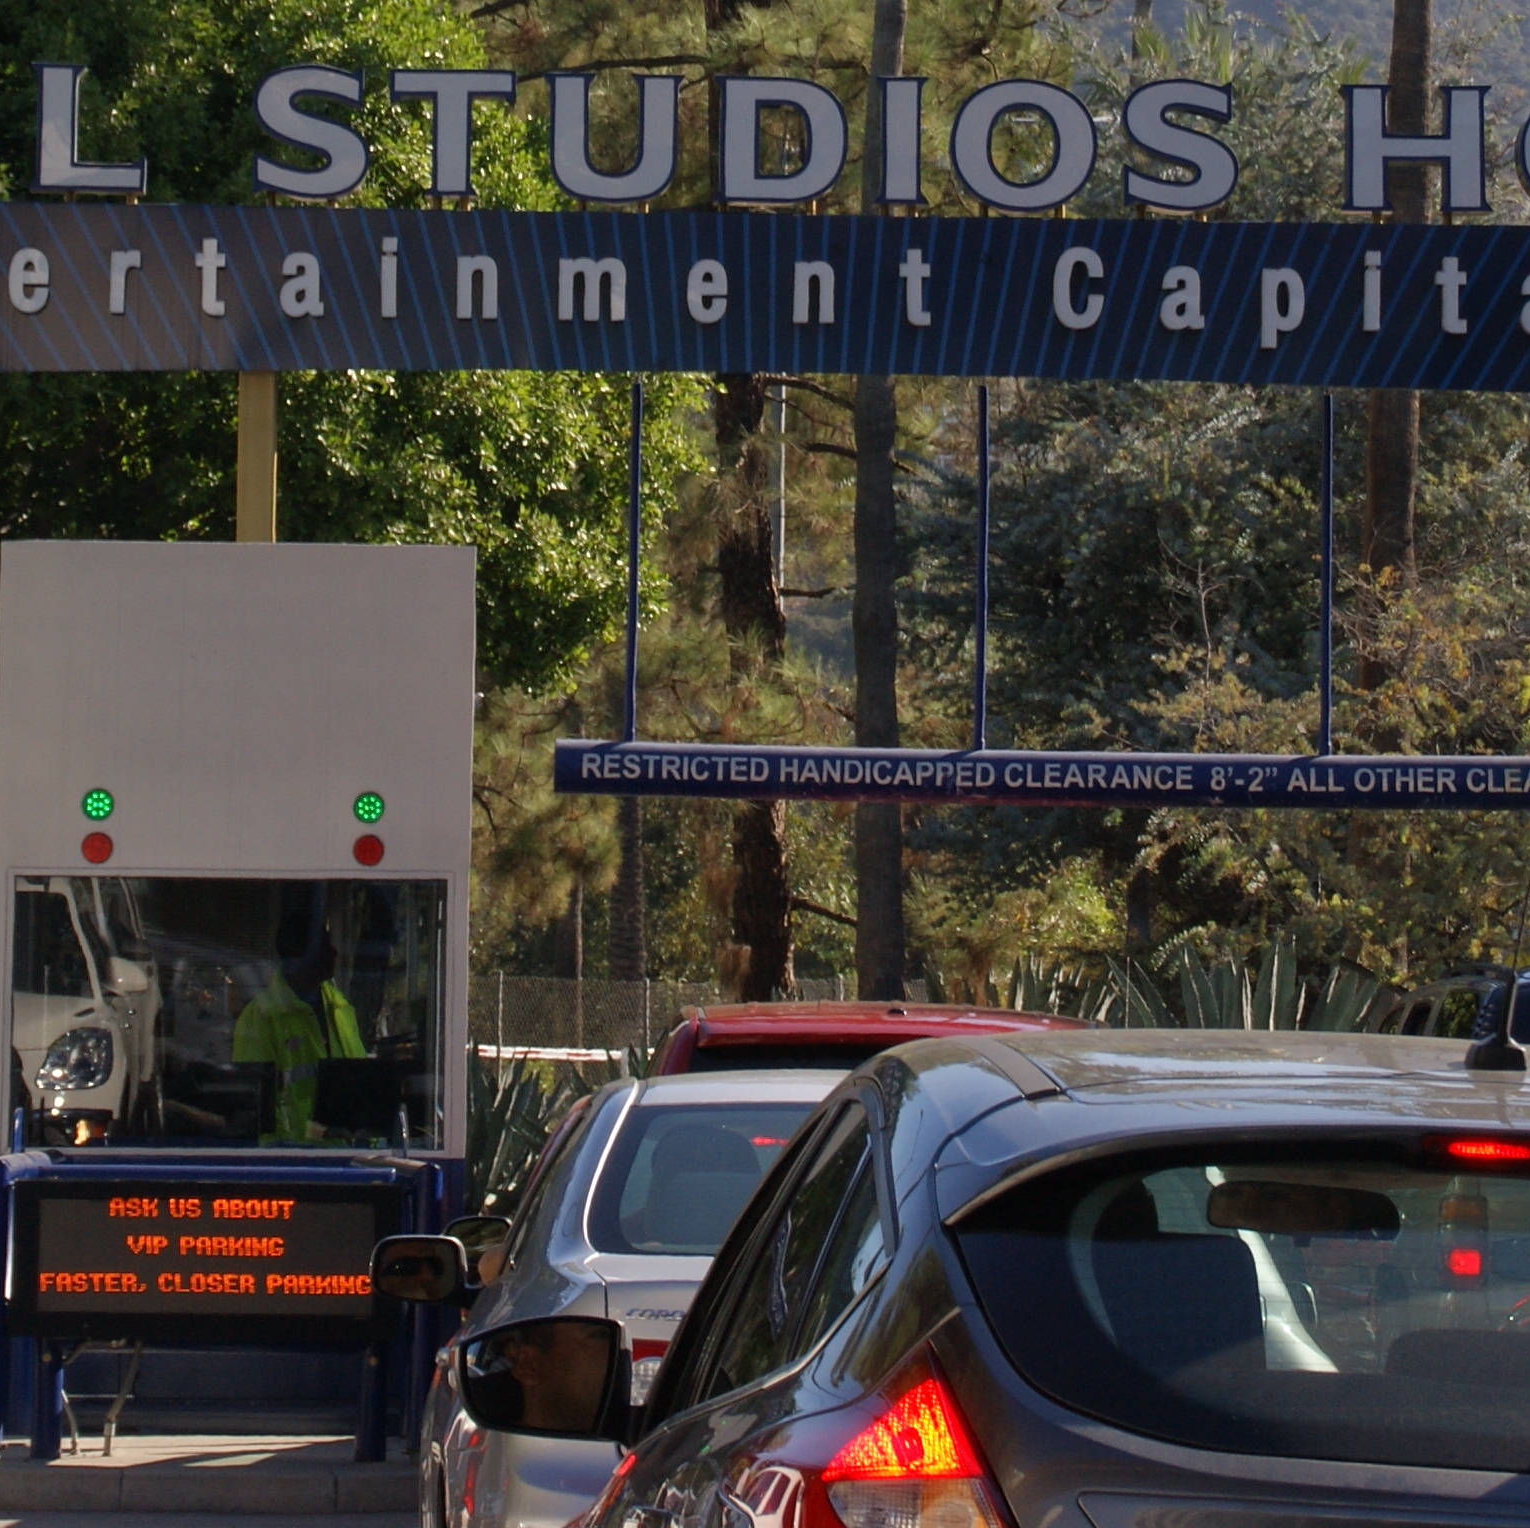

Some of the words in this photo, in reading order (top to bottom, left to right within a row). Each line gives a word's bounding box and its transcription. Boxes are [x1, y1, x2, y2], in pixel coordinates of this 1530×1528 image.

[254, 64, 1239, 212] STUDIOS
[581, 752, 769, 783] RESTRICTED
[779, 757, 996, 788] HANDICAPPED
[1004, 762, 1193, 791] CLEARANCE
[1287, 766, 1346, 792] ALL
[1354, 766, 1457, 793] OTHER
[109, 1197, 158, 1218] ASK
[169, 1198, 201, 1219] US
[212, 1198, 294, 1220] ABOUT
[125, 1235, 168, 1256] VIP
[179, 1235, 285, 1258] PARKING
[39, 1272, 148, 1293] FASTER,
[157, 1273, 256, 1294] CLOSER
[266, 1274, 372, 1295] PARKING
